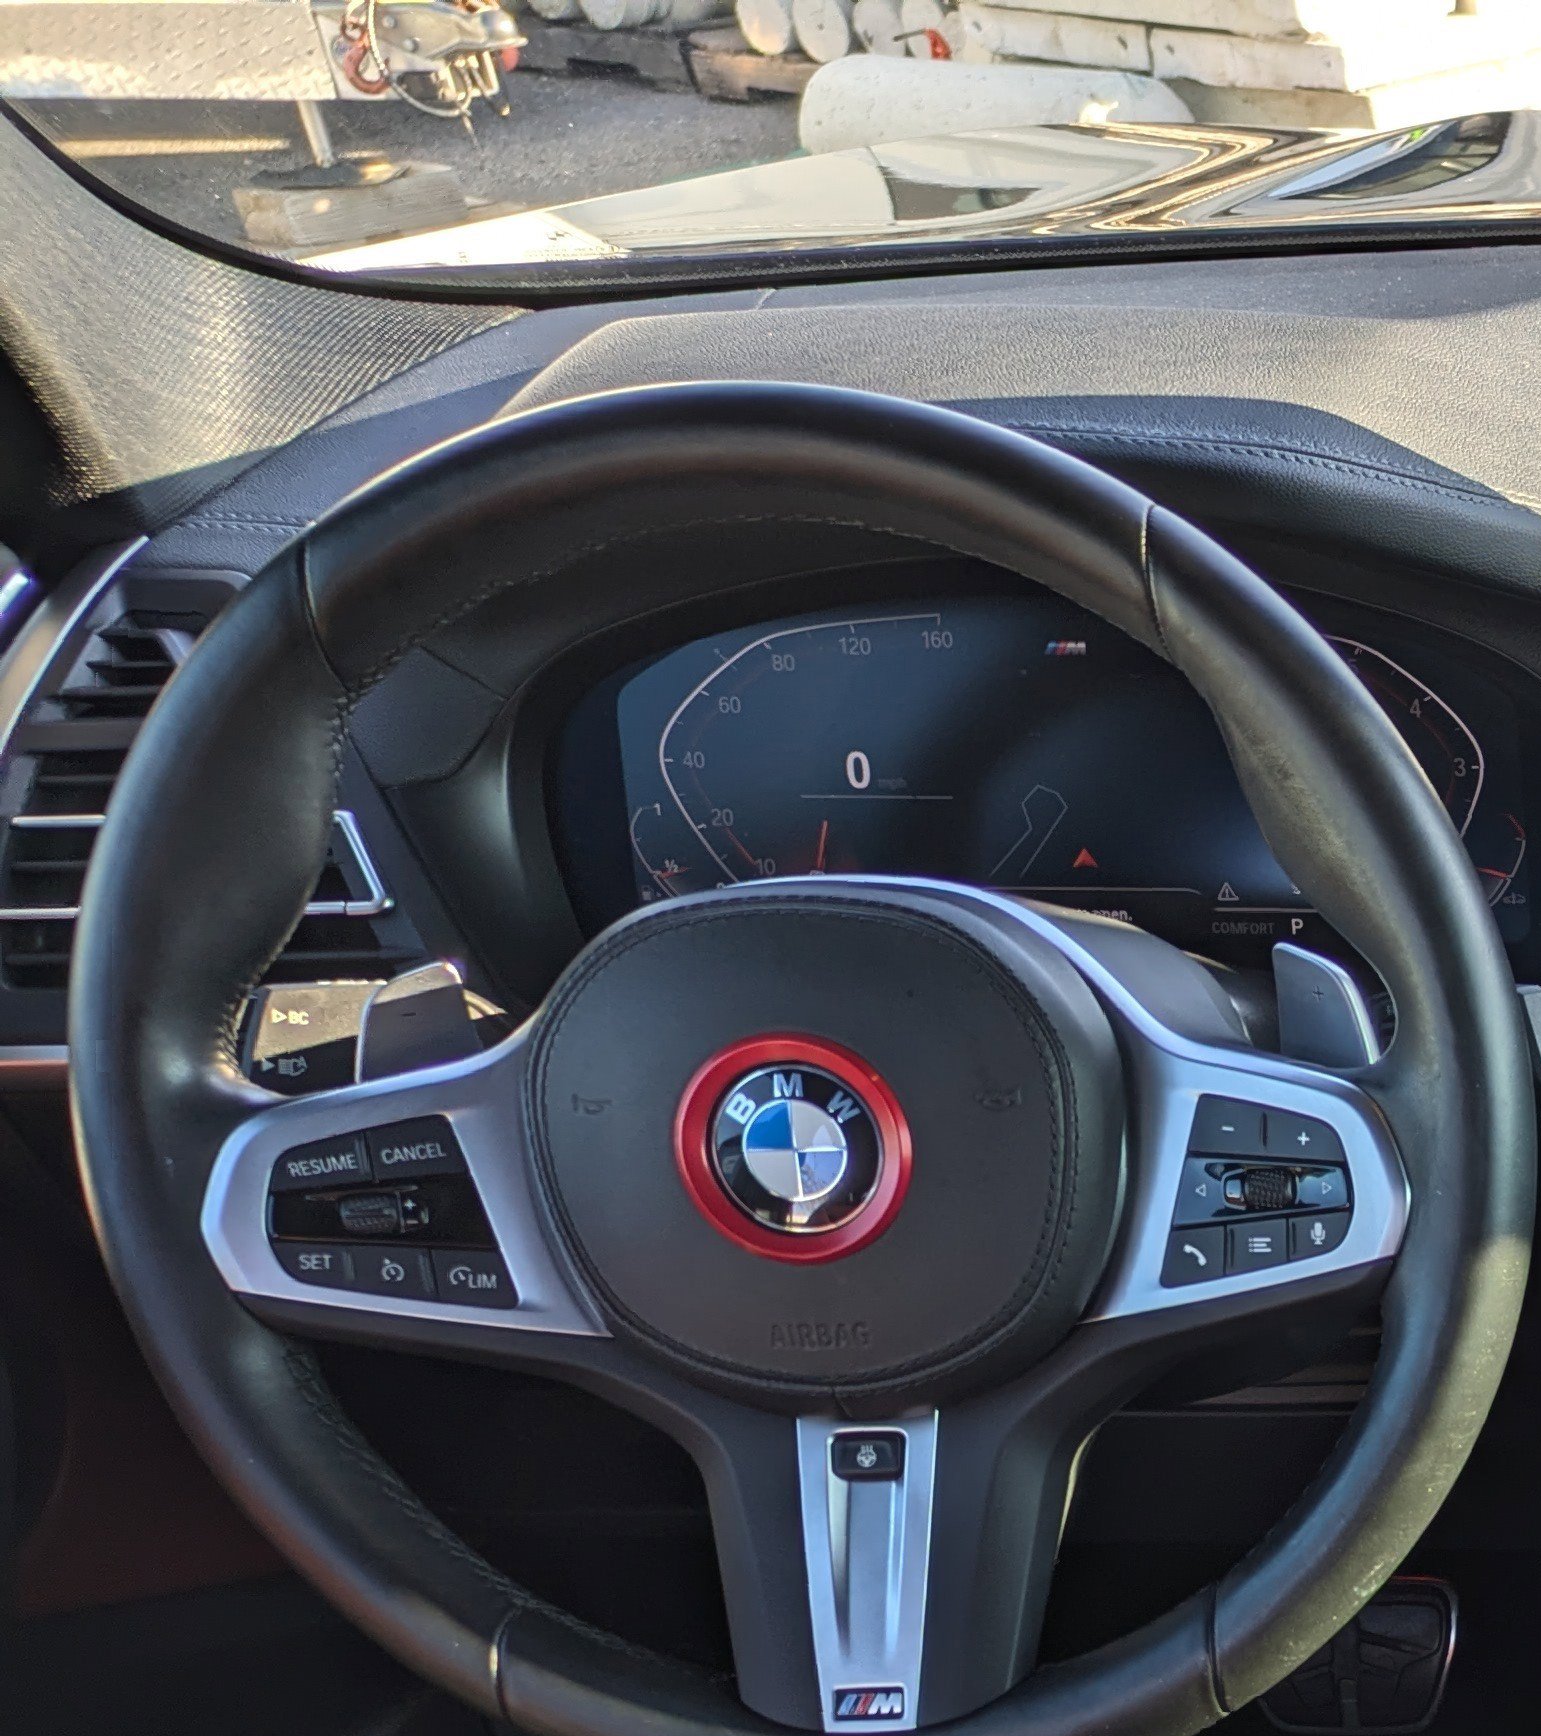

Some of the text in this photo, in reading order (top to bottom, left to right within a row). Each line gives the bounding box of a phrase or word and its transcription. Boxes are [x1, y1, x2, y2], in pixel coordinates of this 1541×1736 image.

[838, 636, 871, 656] 120
[921, 630, 953, 649] 160
[772, 653, 795, 672] 80
[718, 695, 742, 714] 60
[1410, 698, 1422, 718] 4
[682, 750, 705, 769] 40
[1453, 758, 1466, 777] 3
[846, 750, 871, 789] 0
[711, 808, 734, 826] 20
[756, 858, 776, 875] 10
[1211, 922, 1275, 934] COMFORT
[1291, 918, 1304, 935] P
[727, 1072, 861, 1124] BMW
[380, 1142, 447, 1165] CANCEL
[287, 1153, 358, 1178] RESUME
[298, 1253, 332, 1270] SET
[467, 1273, 497, 1289] LIM
[769, 1321, 874, 1351] AIRBAG
